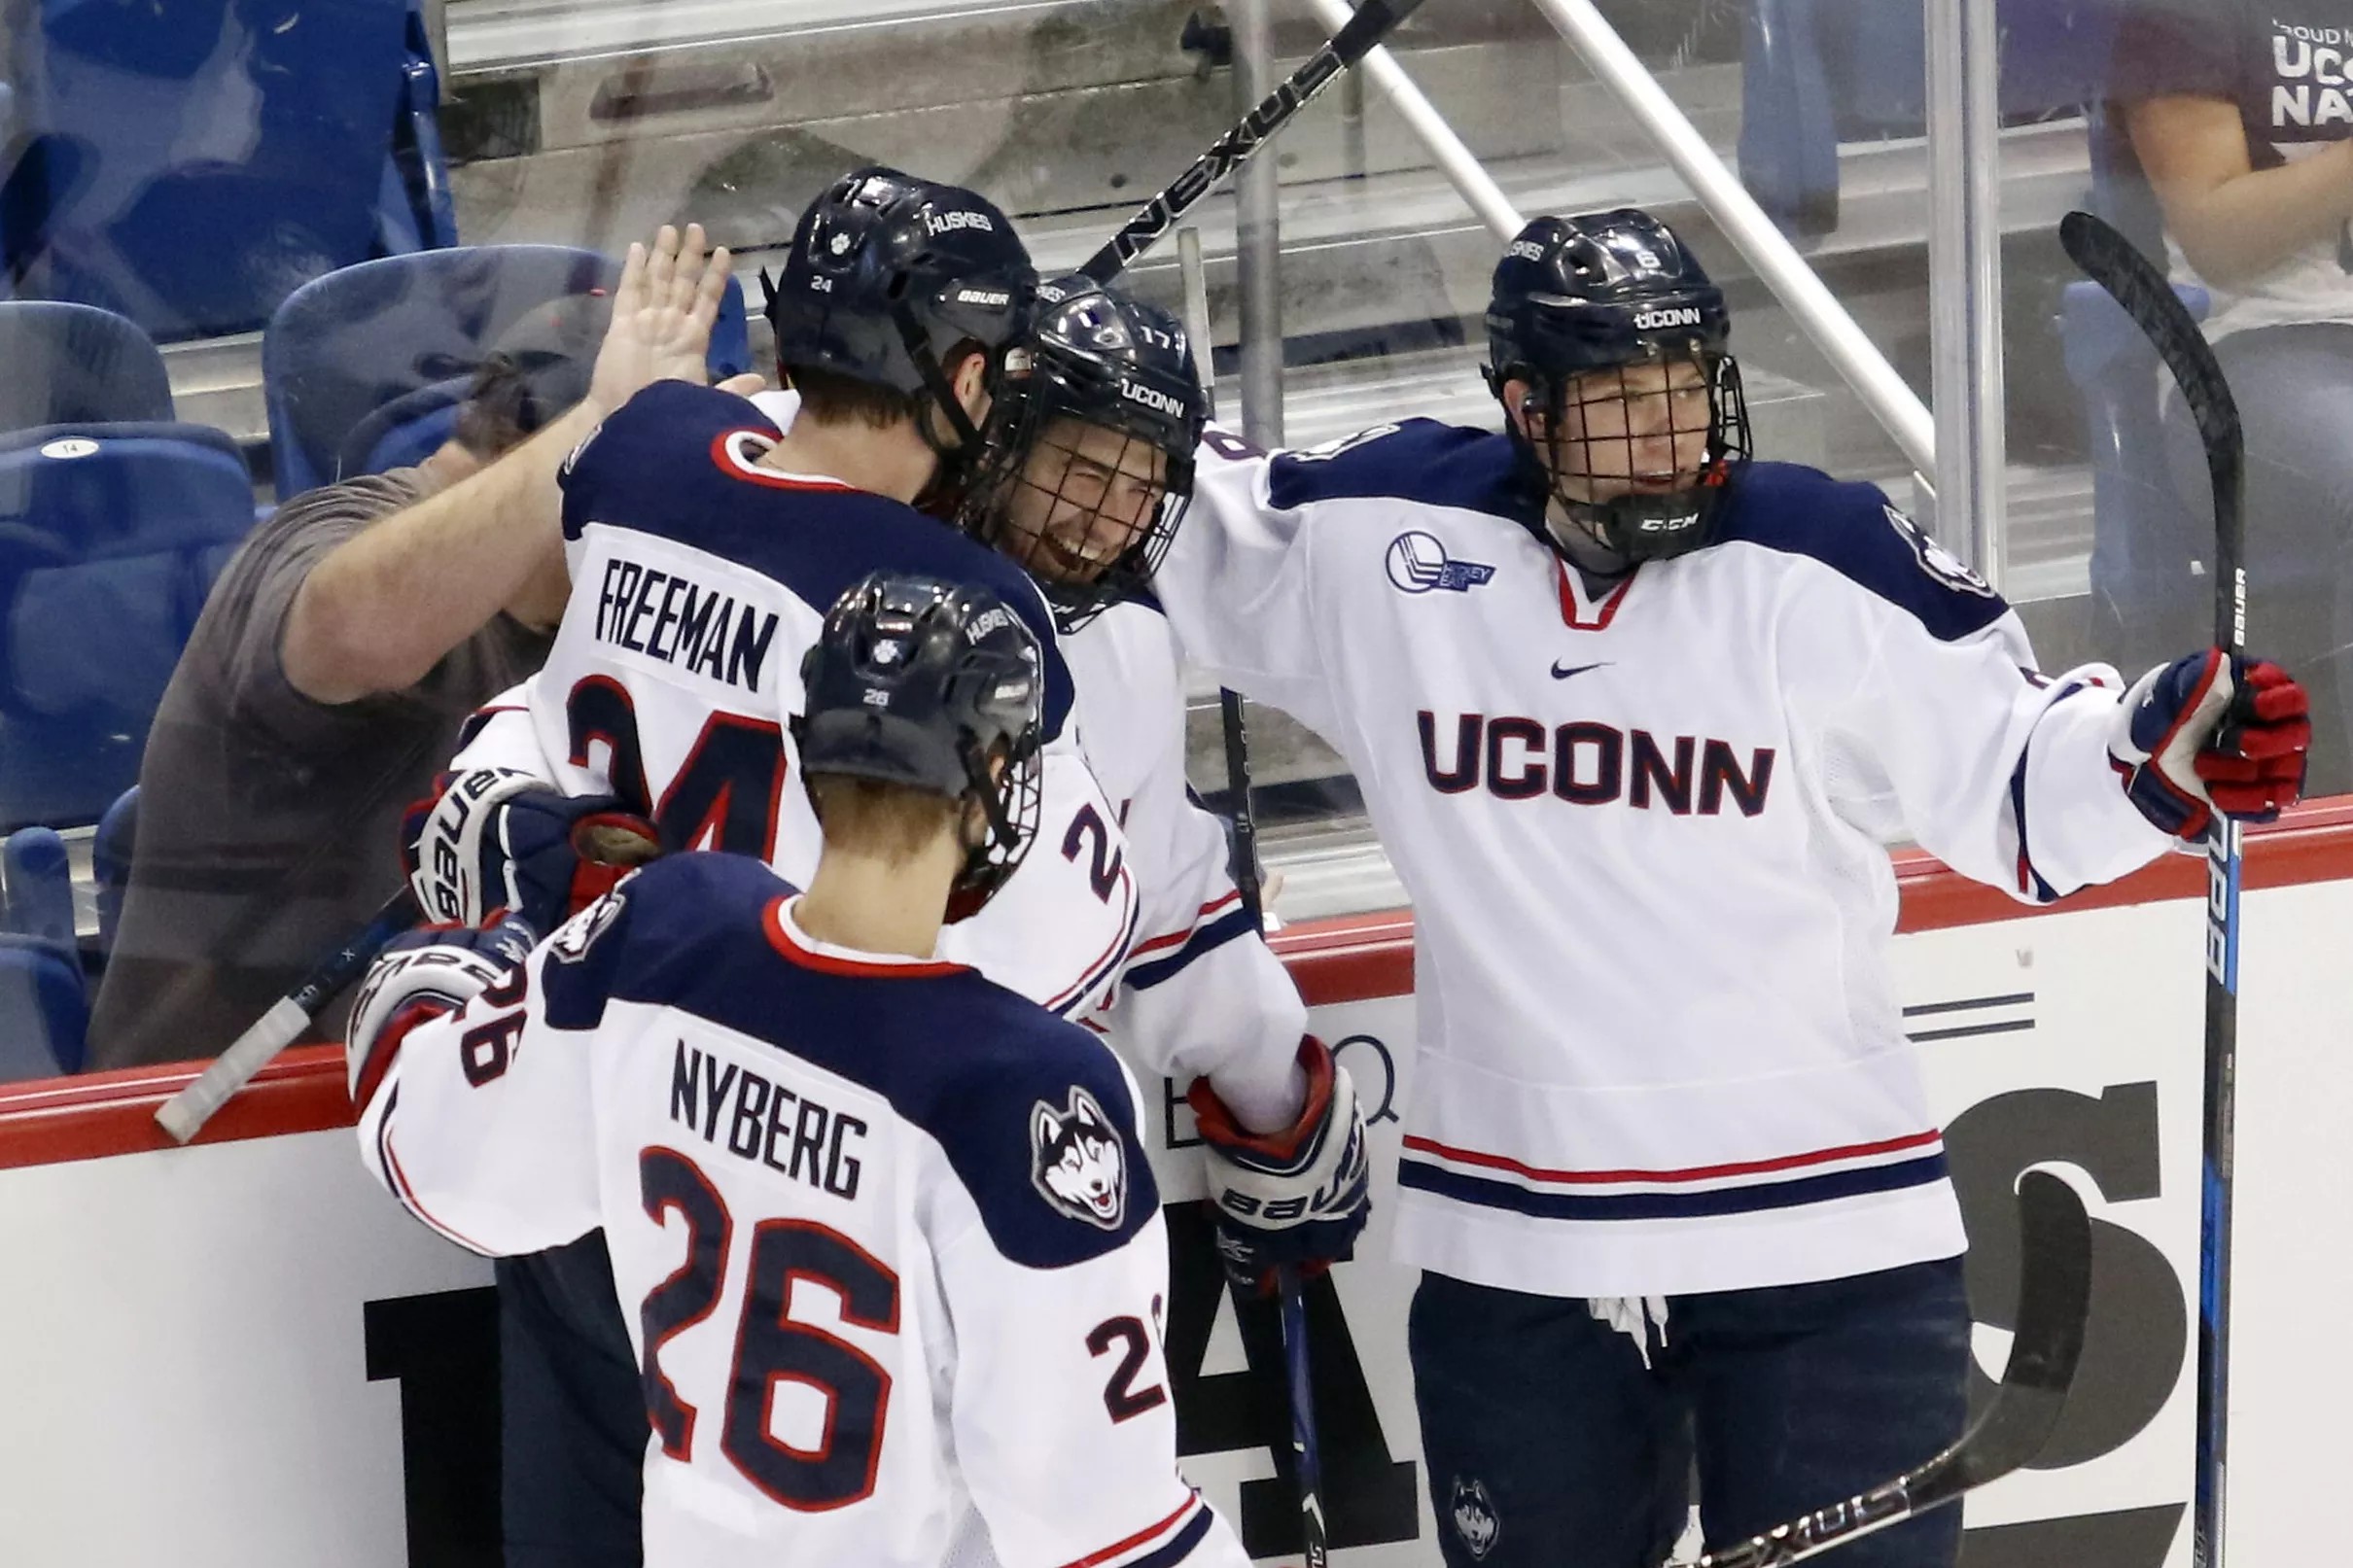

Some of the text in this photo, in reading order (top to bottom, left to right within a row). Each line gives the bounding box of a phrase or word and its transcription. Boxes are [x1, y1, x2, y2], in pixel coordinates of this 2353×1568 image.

[2272, 85, 2353, 126] NA
[1112, 39, 1348, 267] NEXUS
[926, 211, 993, 237] HUSKIES
[810, 274, 833, 294] 24
[1633, 307, 1701, 331] UCONN
[1140, 325, 1171, 350] 17
[1120, 377, 1185, 419] UCONN
[1640, 511, 1700, 532] CCM
[595, 558, 779, 693] FREEMAN
[862, 687, 891, 708] 26
[566, 673, 788, 865] 24
[1417, 710, 1776, 819] UCONN
[2206, 813, 2229, 986] BAU
[670, 1038, 868, 1201] NYBERG
[639, 1145, 900, 1514] 26
[1085, 1294, 1167, 1425] 2
